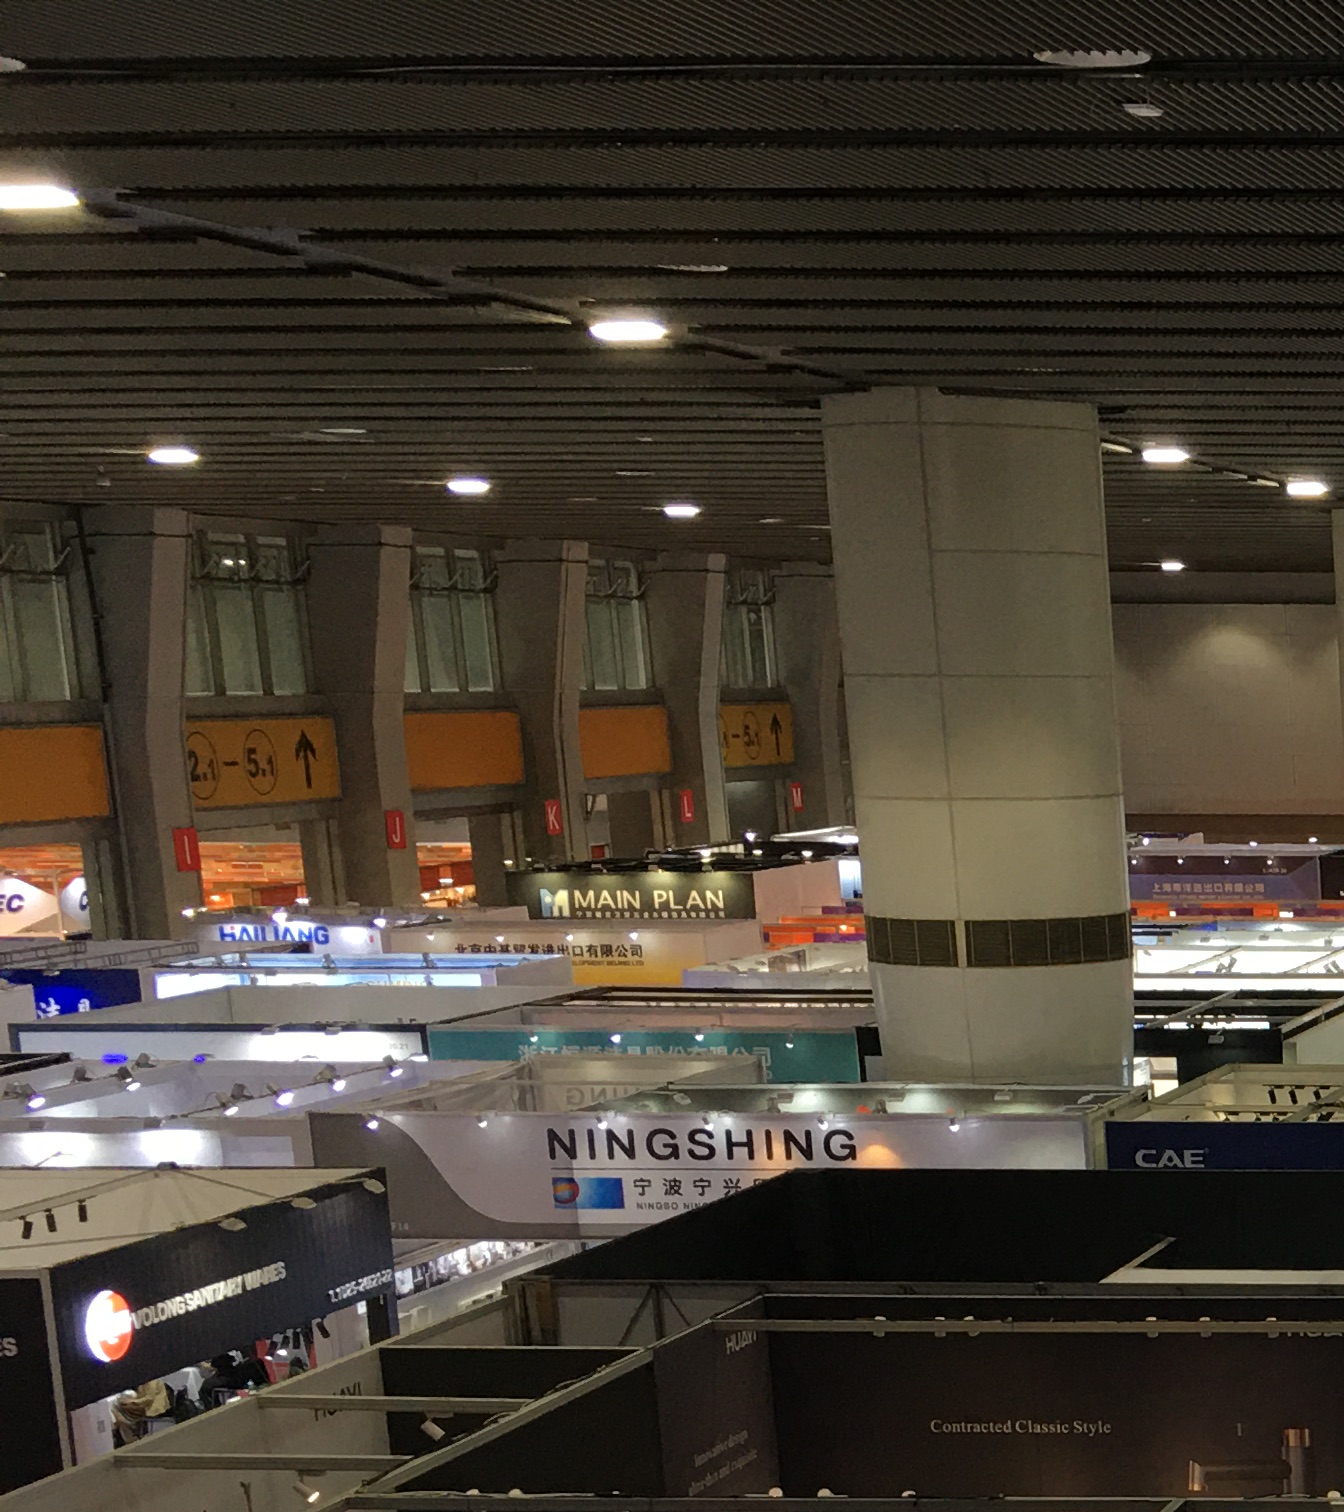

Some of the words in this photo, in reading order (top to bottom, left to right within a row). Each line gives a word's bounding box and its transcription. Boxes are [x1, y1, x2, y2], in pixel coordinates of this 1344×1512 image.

[548, 806, 560, 830] K
[683, 796, 692, 818] L
[391, 817, 402, 844] J
[573, 889, 640, 909] MAIN
[653, 889, 725, 909] PLAN
[546, 1127, 858, 1162] NINGSHING
[1134, 1149, 1206, 1169] CAE
[929, 1418, 1013, 1435] Contracted
[1014, 1418, 1070, 1435] Classic
[1072, 1418, 1112, 1438] Style
